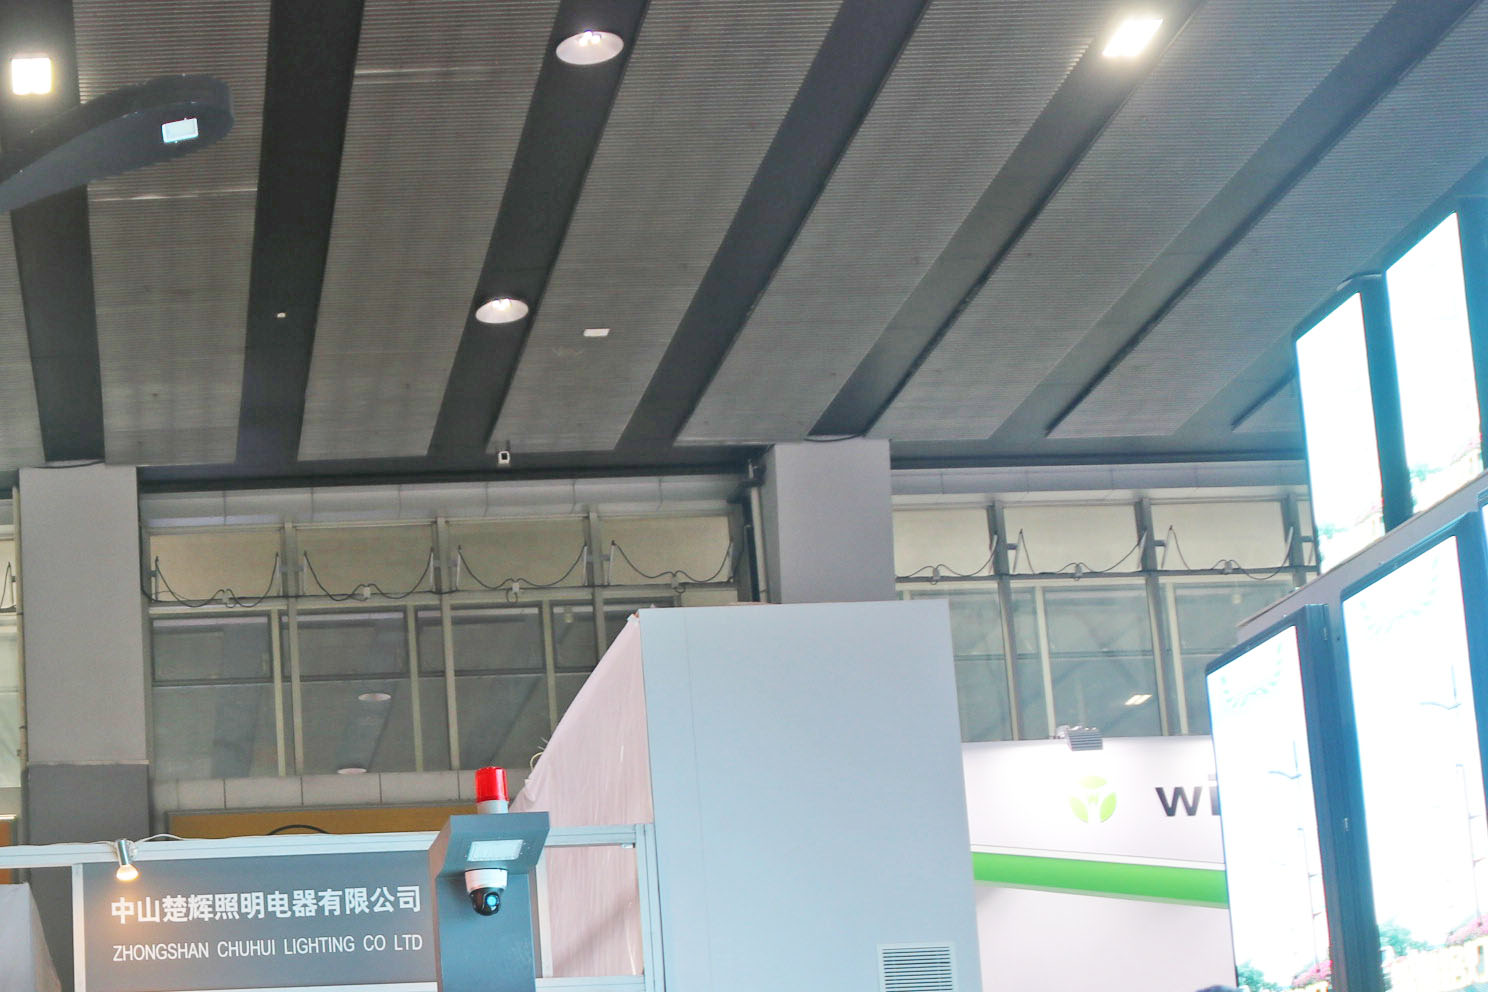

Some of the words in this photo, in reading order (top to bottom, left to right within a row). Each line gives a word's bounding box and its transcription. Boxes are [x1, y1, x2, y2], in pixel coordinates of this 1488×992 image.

[111, 886, 421, 924] 中山楚辉照明电器有限公司
[112, 942, 210, 962] ZHONGSHAN
[217, 939, 276, 958] CHUHUI
[283, 936, 355, 955] LIGHTING
[363, 935, 386, 951] CO
[394, 934, 423, 951] LTD
